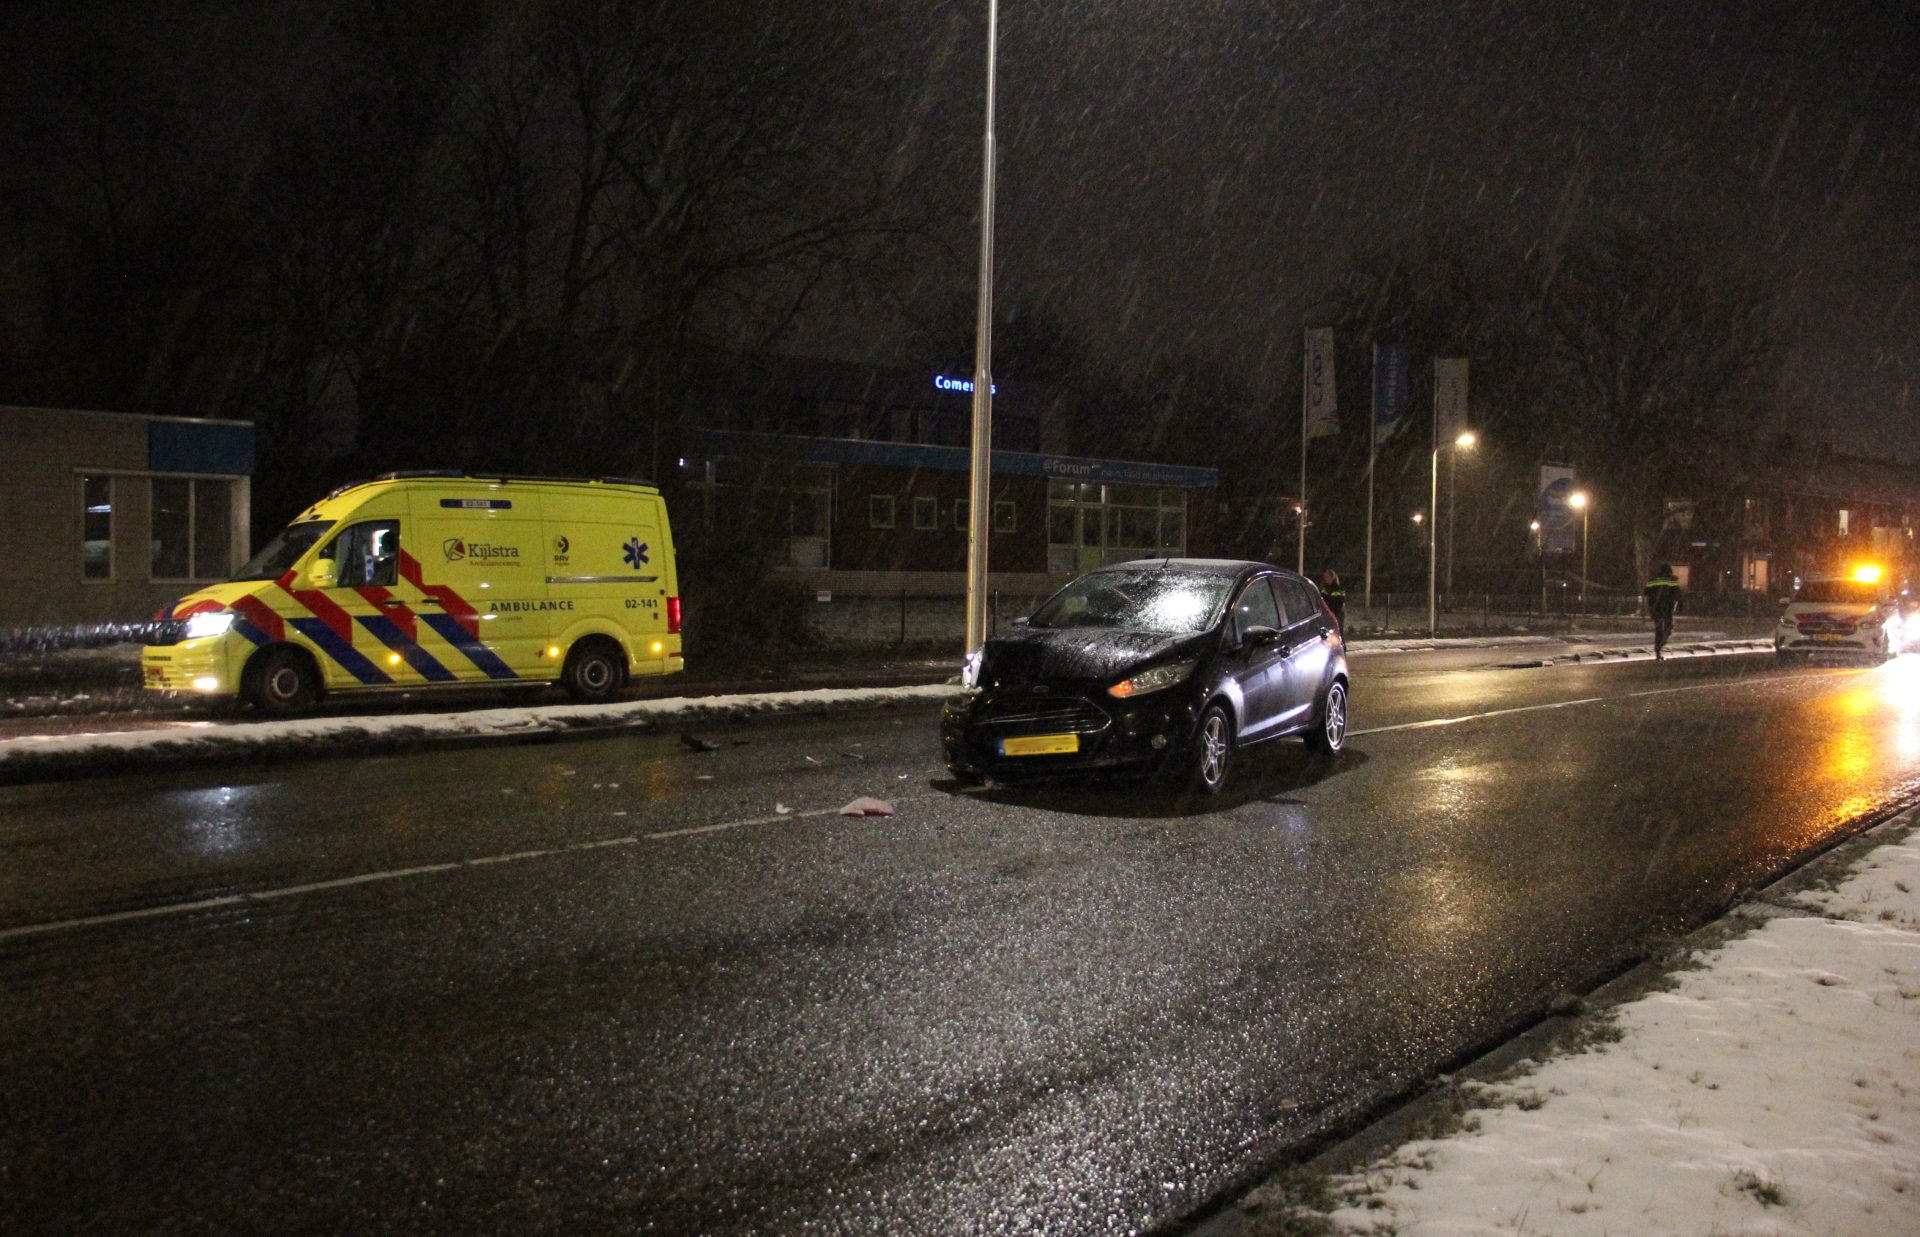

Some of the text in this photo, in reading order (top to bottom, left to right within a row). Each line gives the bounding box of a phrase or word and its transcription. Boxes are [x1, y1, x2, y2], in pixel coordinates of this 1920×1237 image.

[935, 375, 996, 394] Comes
[467, 543, 520, 560] Kijlstra
[490, 600, 574, 612] AMBULANCE
[625, 599, 658, 609] 02-141
